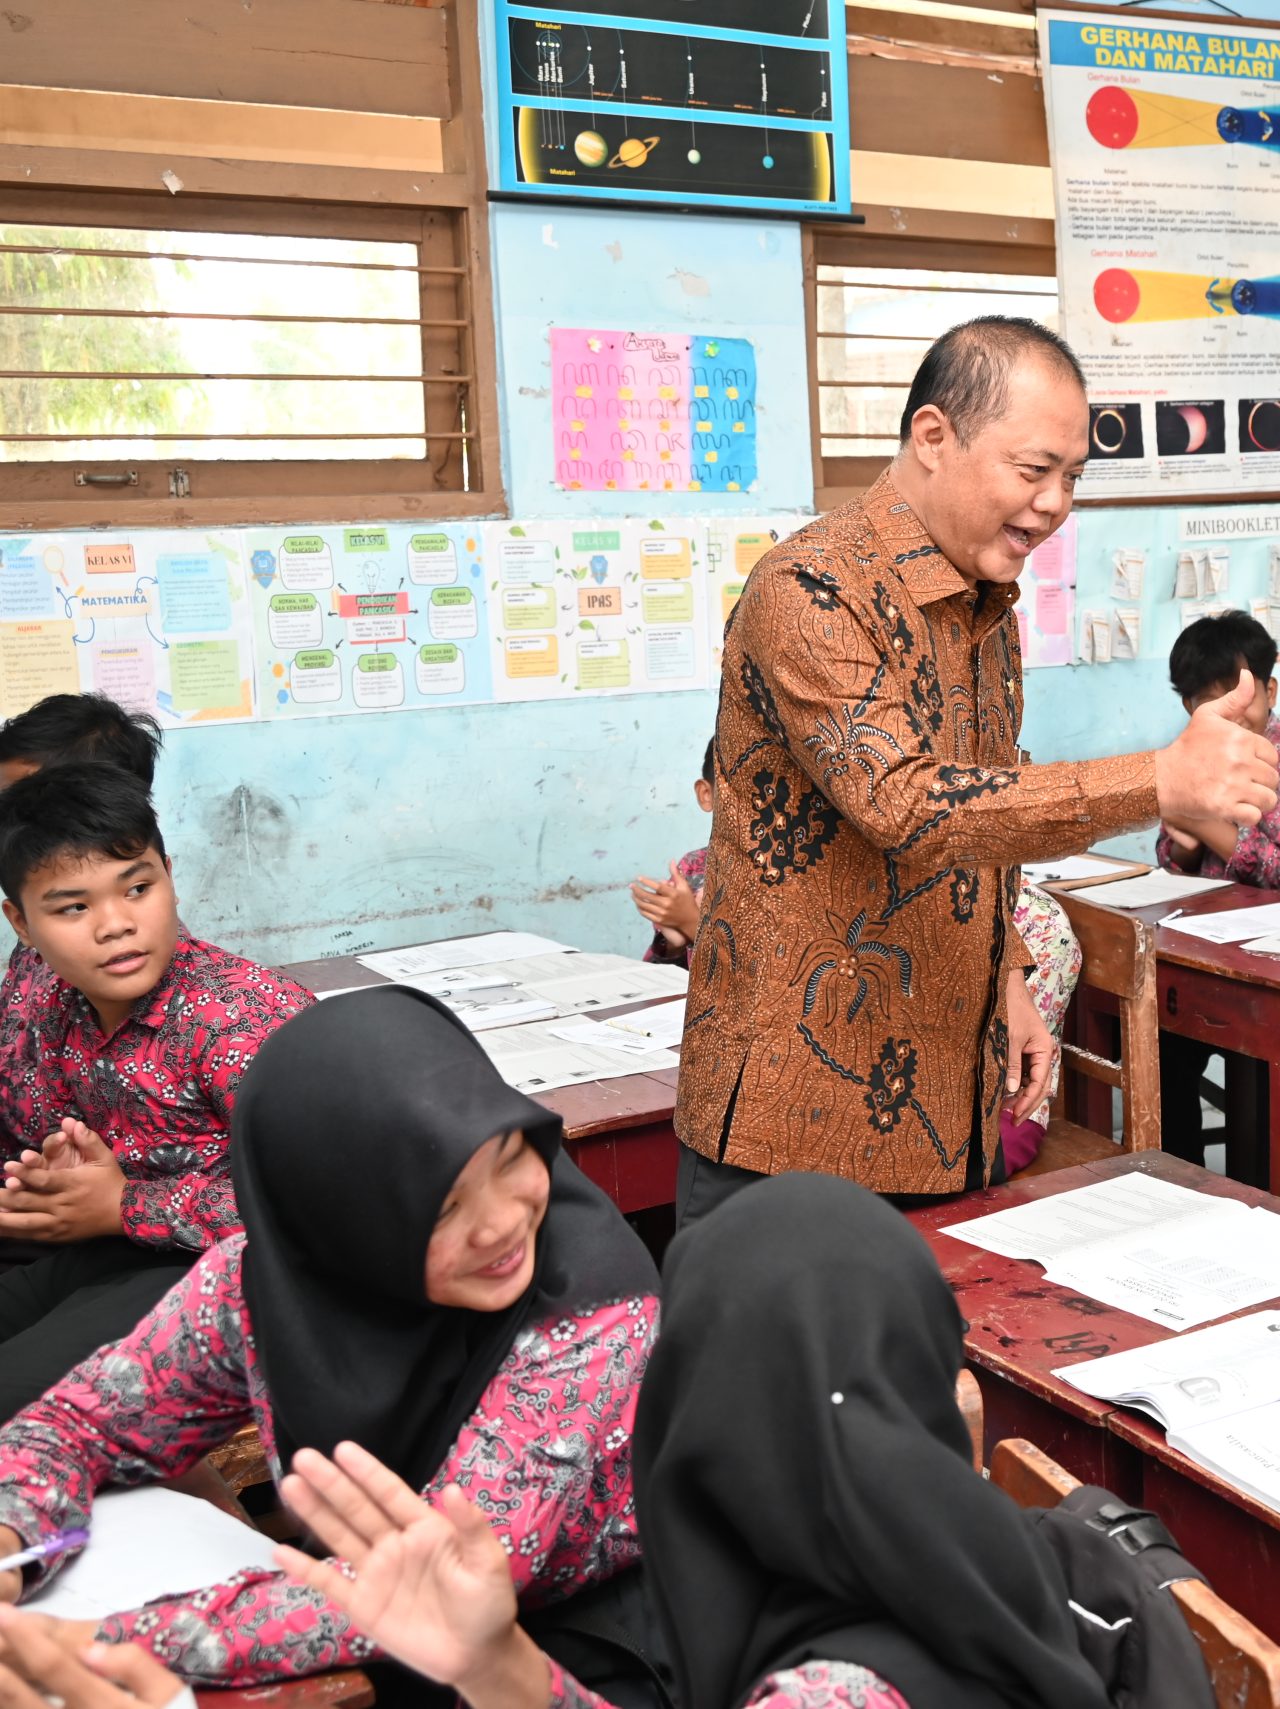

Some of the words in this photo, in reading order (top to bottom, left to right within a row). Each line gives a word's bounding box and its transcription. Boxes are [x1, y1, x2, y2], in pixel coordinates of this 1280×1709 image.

[535, 21, 562, 31] Matahari
[1080, 25, 1201, 54] GERHANA
[1095, 47, 1147, 69] DAN
[1154, 53, 1275, 79] MATAHARI
[1087, 72, 1118, 85] Gerhana
[1119, 75, 1141, 85] Bulan
[1091, 249, 1124, 259] Gerhana
[1125, 249, 1158, 259] Matahari
[87, 553, 120, 567] KELAS
[121, 553, 133, 564] VI
[81, 594, 148, 607] MATEMATIKA
[587, 594, 613, 608] IPAS
[1226, 1434, 1275, 1469] Pancasila
